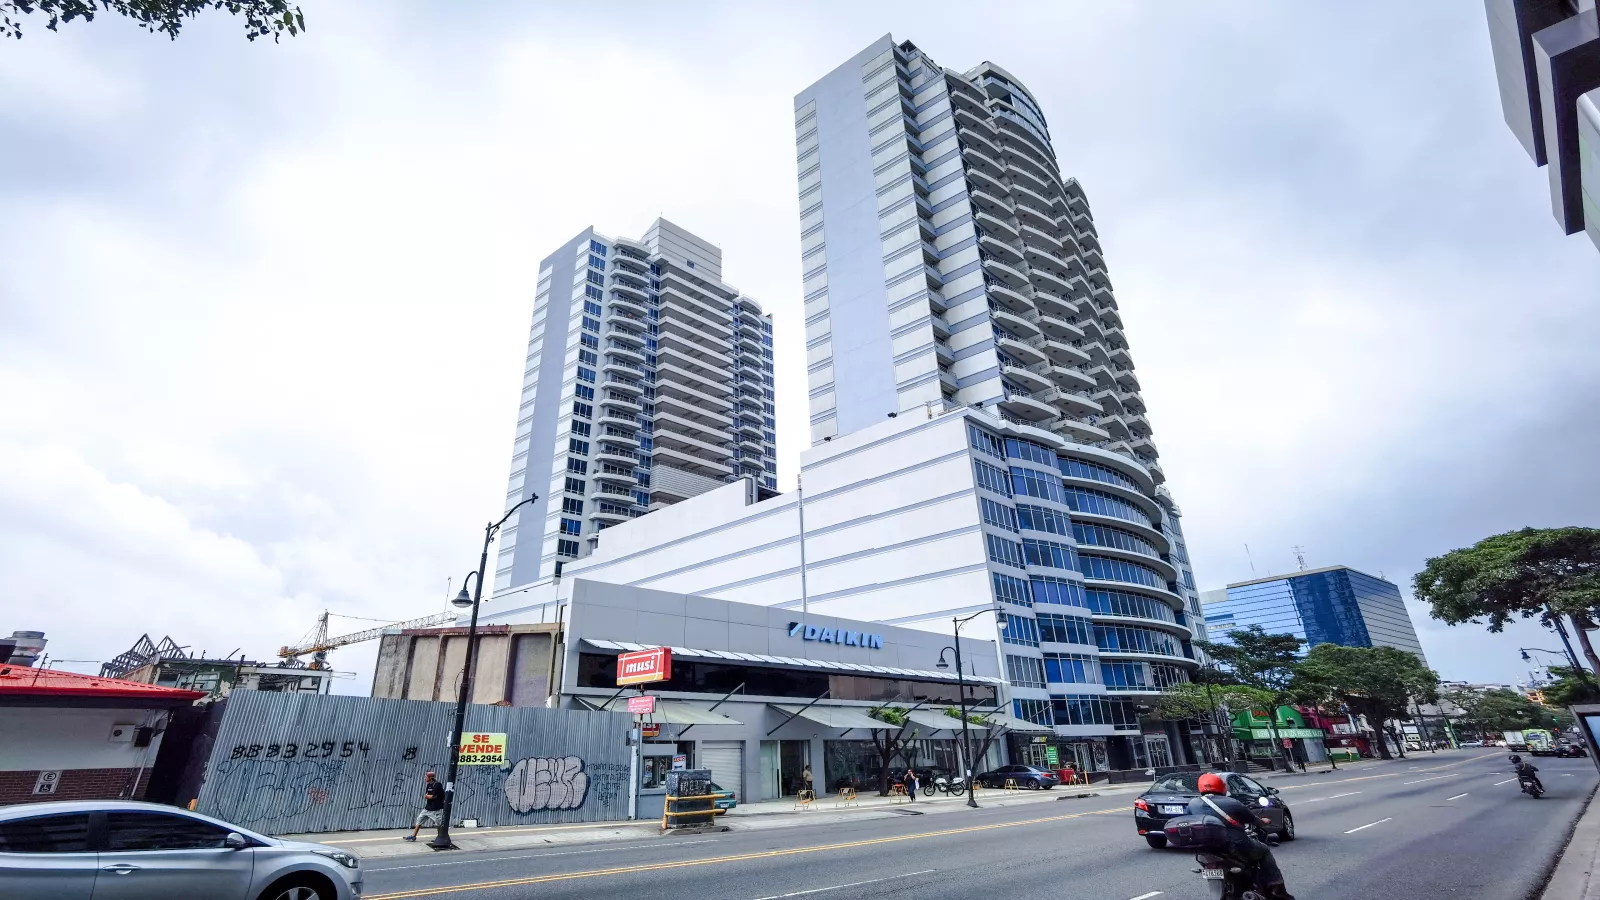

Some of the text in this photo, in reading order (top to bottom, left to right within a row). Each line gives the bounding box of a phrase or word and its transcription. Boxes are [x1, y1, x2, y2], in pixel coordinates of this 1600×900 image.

[803, 624, 884, 649] DAIKIN
[625, 655, 655, 674] musi
[472, 734, 490, 743] SE
[458, 744, 502, 753] VENDE
[458, 754, 502, 763] 883-2954
